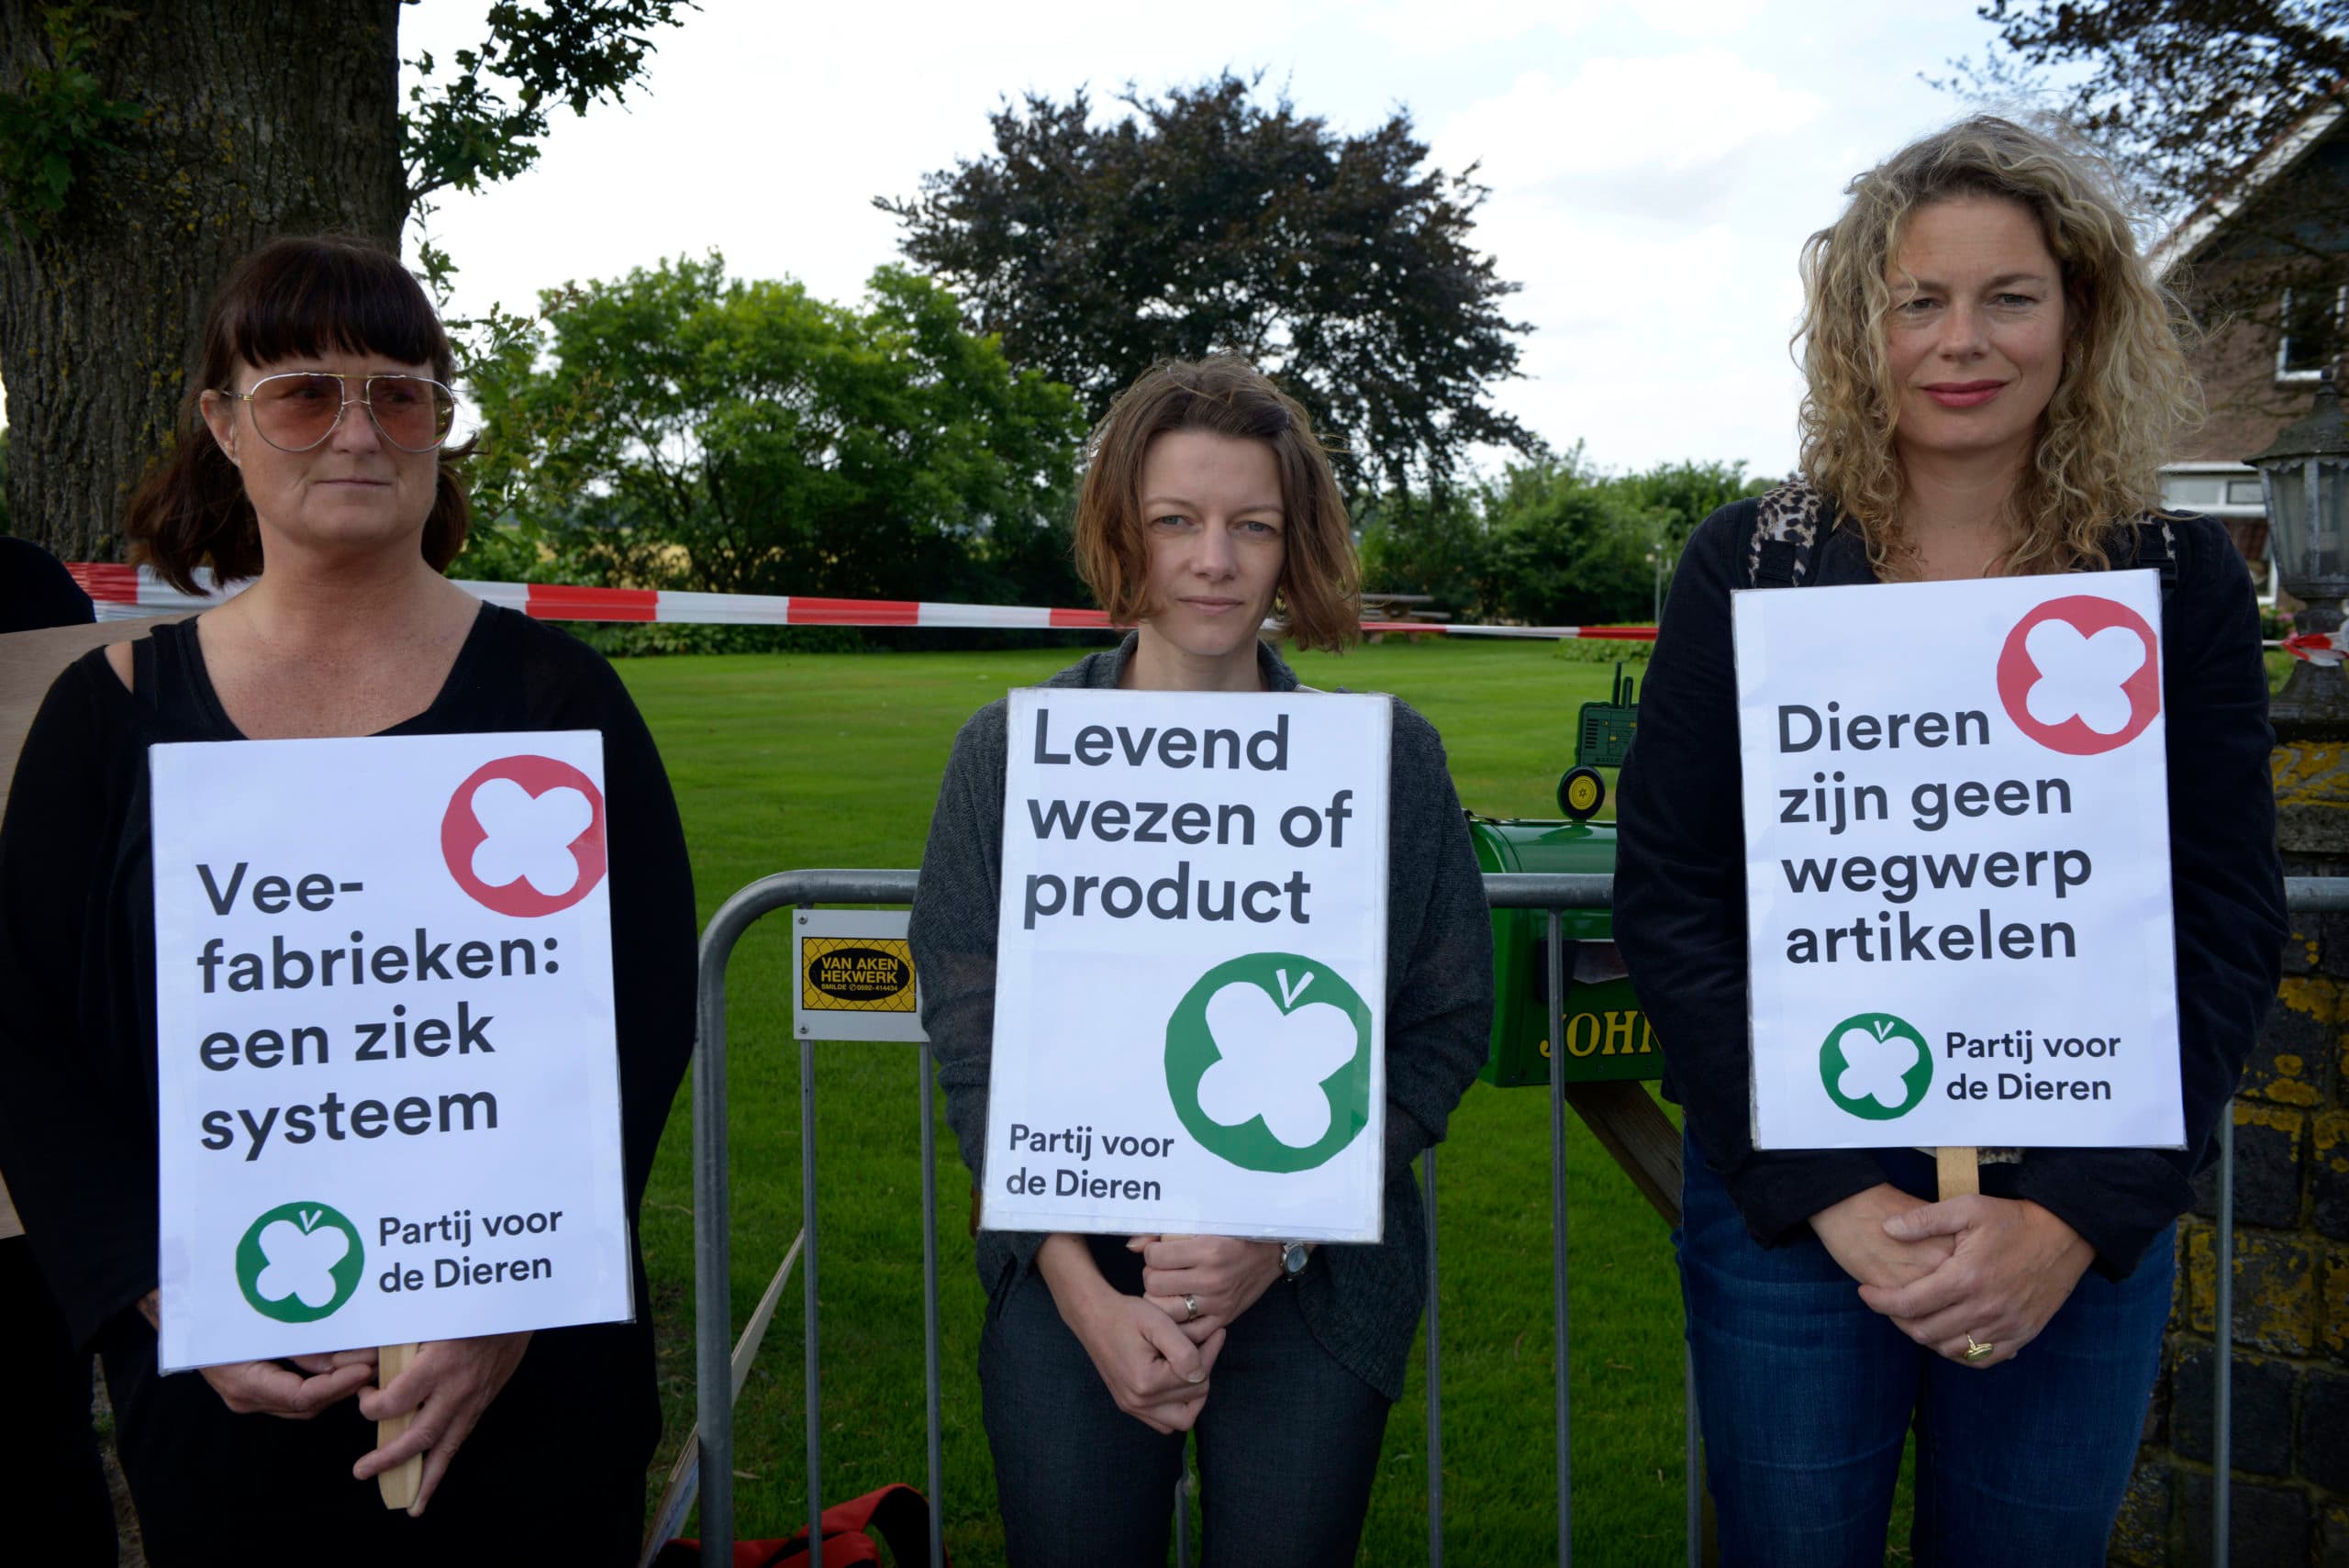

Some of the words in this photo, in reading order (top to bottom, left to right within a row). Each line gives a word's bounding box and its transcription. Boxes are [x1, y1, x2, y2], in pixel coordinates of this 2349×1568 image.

[1034, 709, 1289, 772] Levend
[1778, 702, 1990, 753] Dieren
[1028, 799, 1255, 846] wezen
[1280, 790, 1353, 849] of
[1780, 771, 1888, 835] zijn
[1911, 777, 2072, 832] geen
[196, 862, 363, 917] Vee-
[1024, 862, 1311, 930] product
[1781, 849, 2092, 905] wegwerp
[196, 929, 559, 994] fabrieken:
[822, 957, 852, 970] VAN
[857, 958, 898, 971] AKEN
[1787, 909, 2076, 964] artikelen
[821, 970, 897, 984] HEKWERK
[200, 1026, 329, 1072] een
[355, 1001, 495, 1062] ziek
[1947, 1030, 2032, 1064] Partij
[2043, 1037, 2121, 1058] voor
[1947, 1073, 1988, 1101] de
[1998, 1073, 2111, 1101] Dieren
[202, 1091, 498, 1162] systeem
[1010, 1124, 1092, 1162] Partij
[1102, 1132, 1175, 1159] voor
[1007, 1167, 1047, 1196] de
[1056, 1169, 1161, 1201] Dieren
[380, 1210, 472, 1248] Partij
[483, 1210, 563, 1238] voor
[379, 1262, 424, 1292] de
[435, 1255, 552, 1289] Dieren
